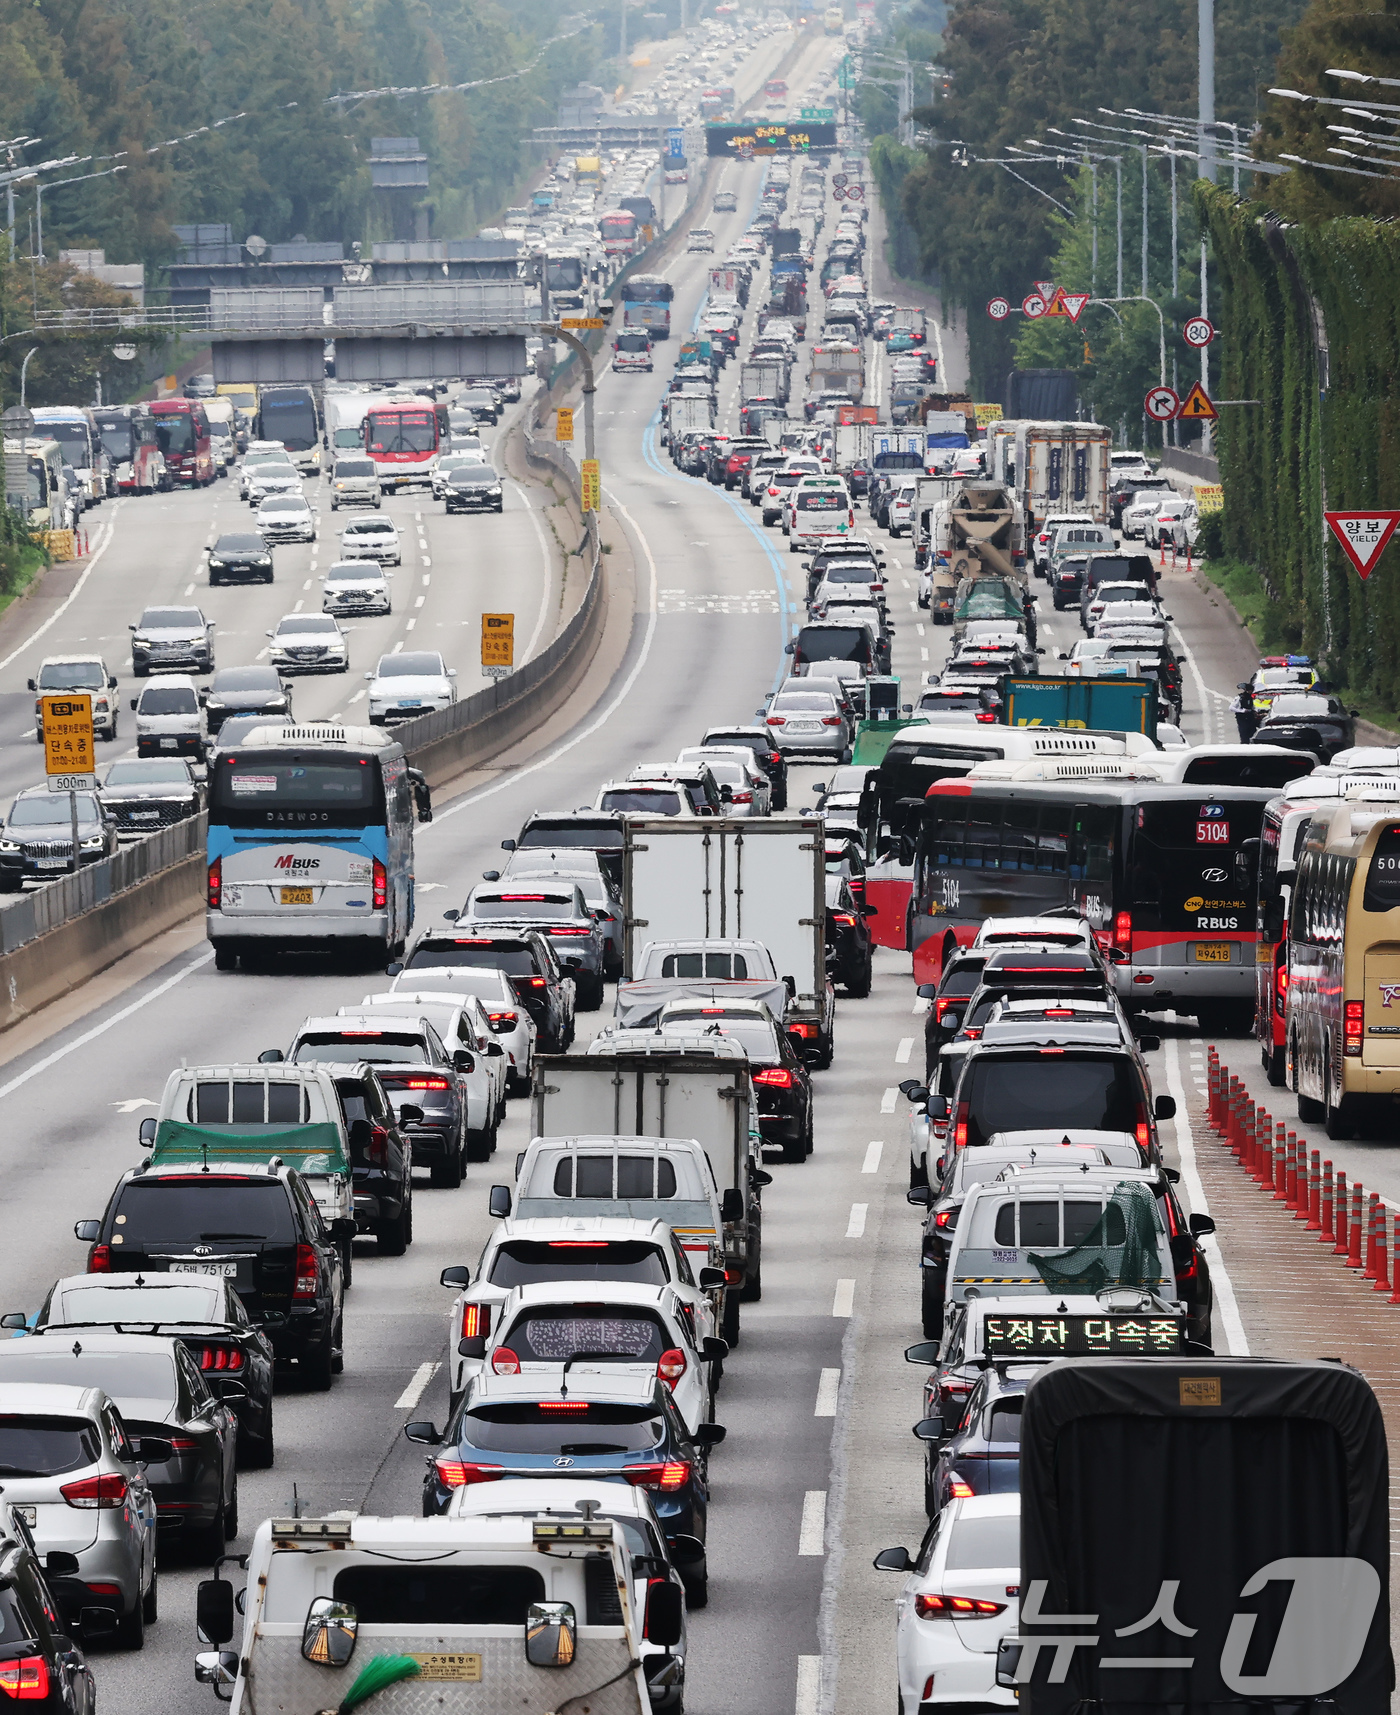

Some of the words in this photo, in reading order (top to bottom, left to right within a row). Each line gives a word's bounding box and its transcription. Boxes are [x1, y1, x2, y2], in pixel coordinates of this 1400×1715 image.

[991, 304, 1006, 315] 80
[1190, 325, 1208, 341] 80
[1345, 521, 1382, 534] 양보
[1349, 535, 1379, 543] YIELD
[1016, 683, 1061, 691] www.kgb.co.kr
[57, 776, 87, 789] 500m
[267, 812, 329, 821] DAEWOO
[1197, 823, 1229, 841] 5104
[942, 879, 960, 908] 5104
[1203, 899, 1247, 909] 천연가스버스
[194, 1246, 212, 1255] KIA
[201, 1264, 232, 1276] 7516
[1084, 1319, 1180, 1350] 단속중
